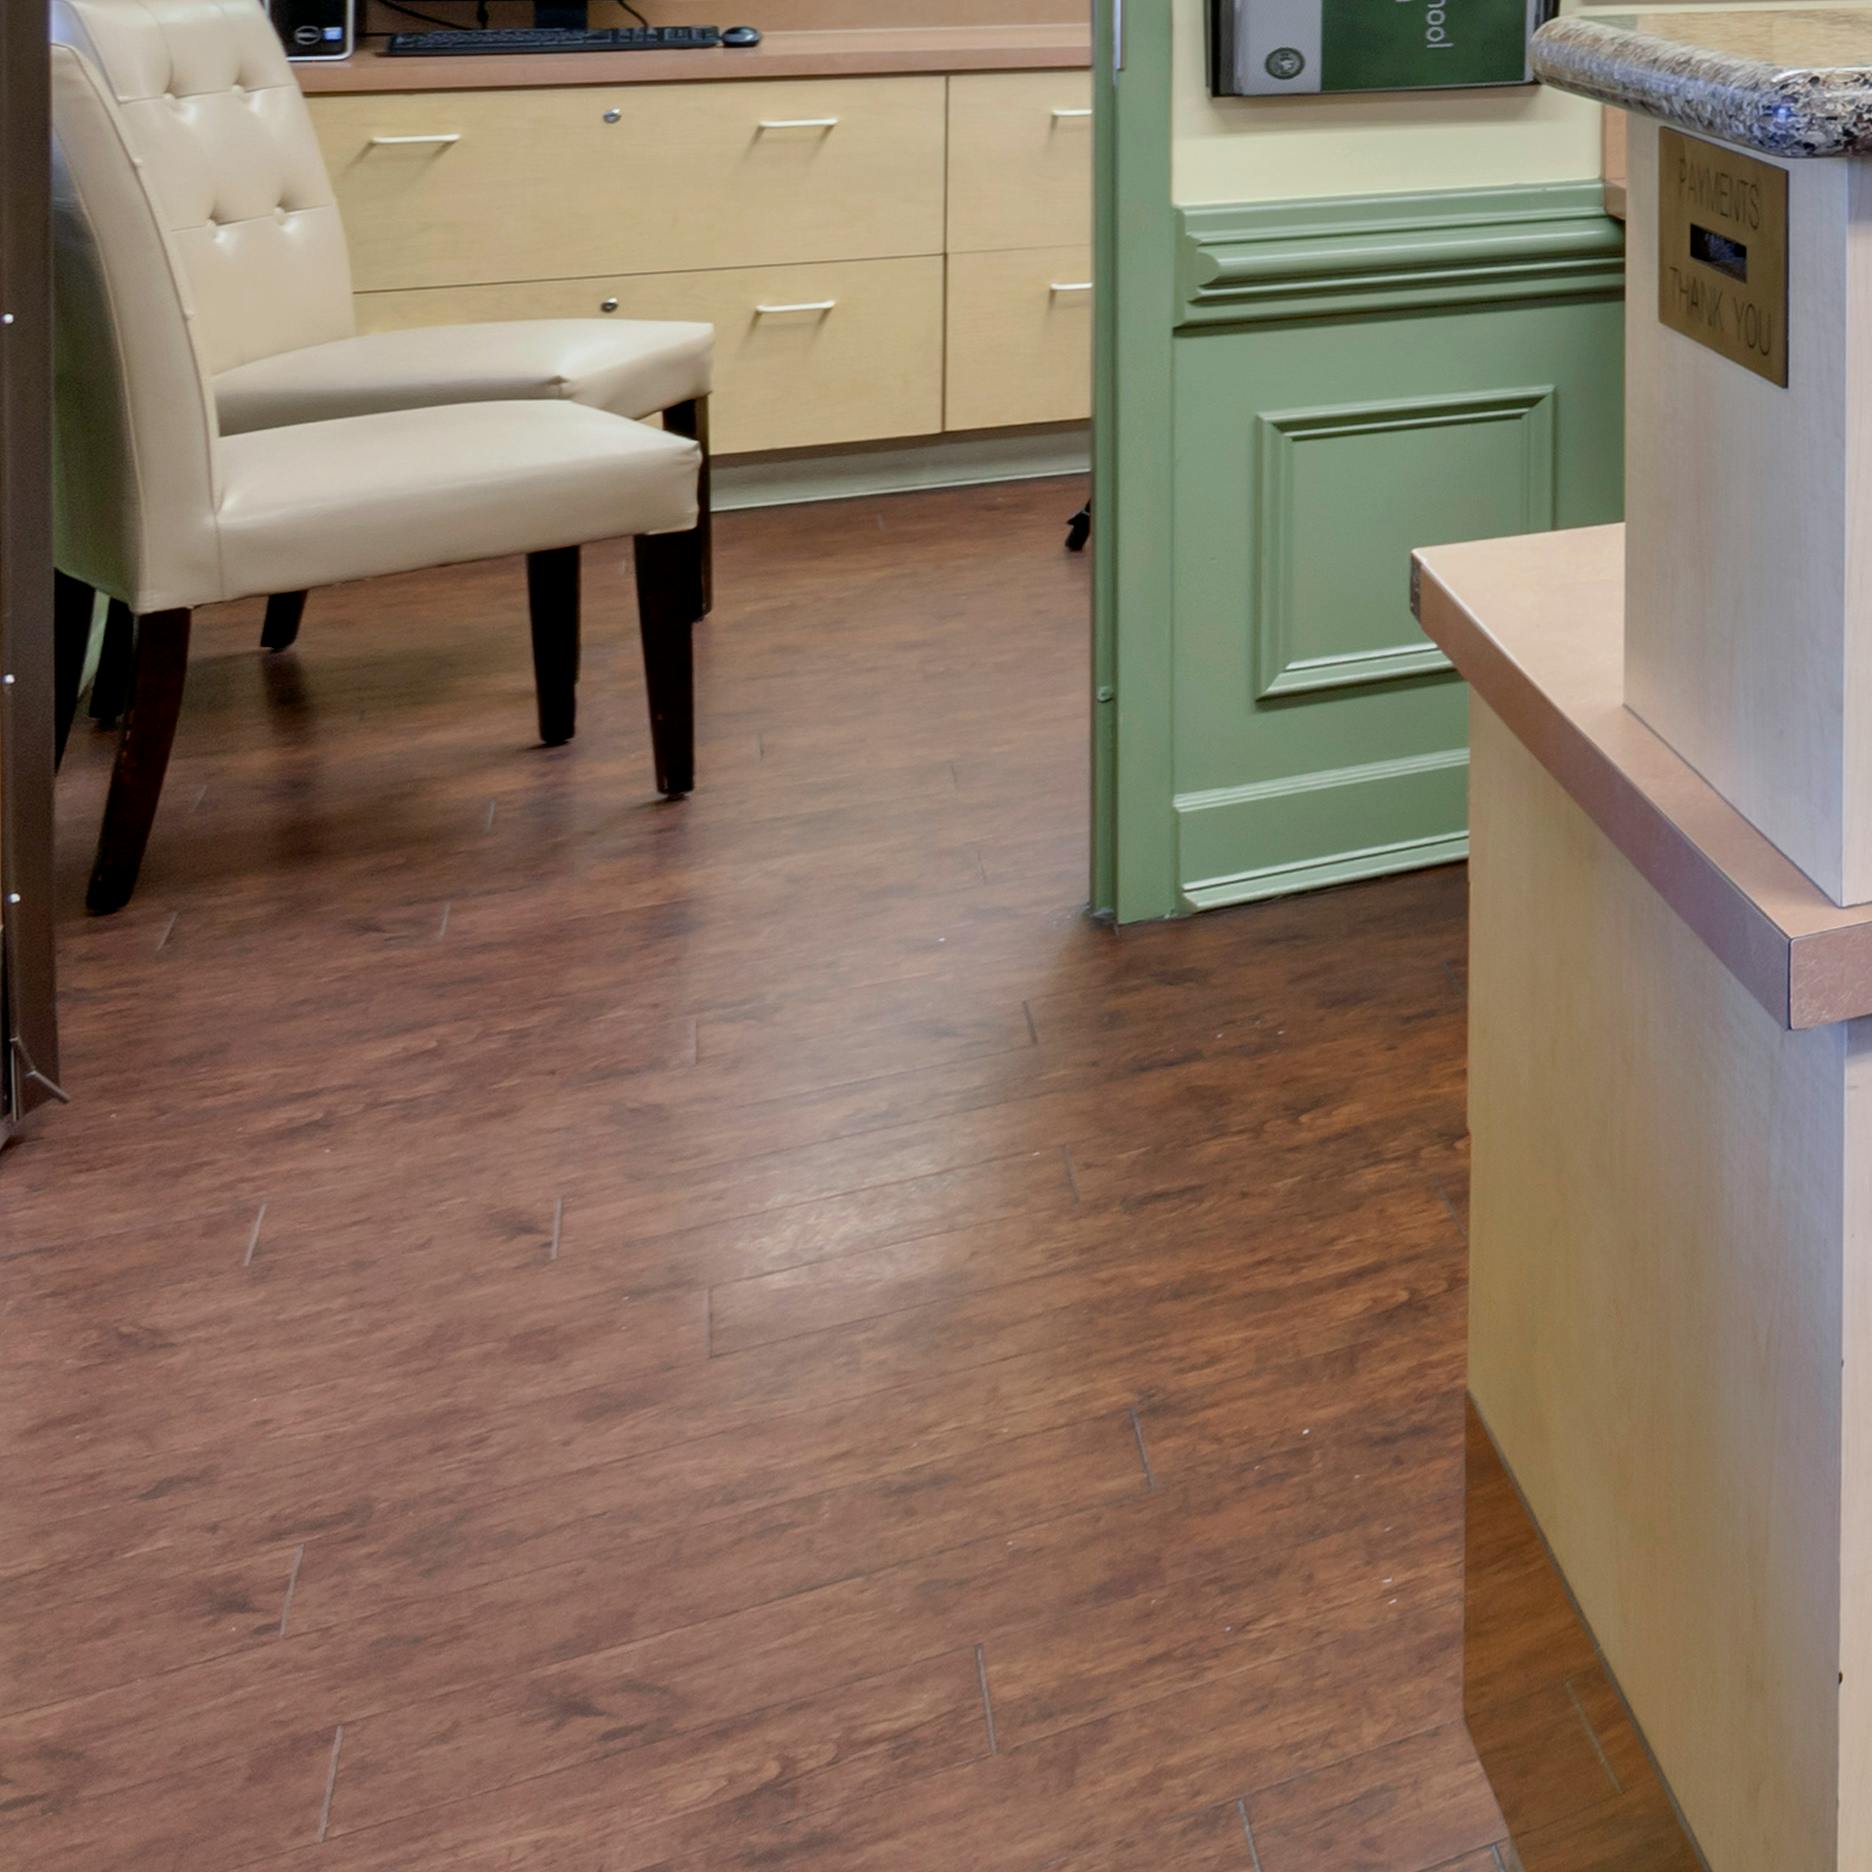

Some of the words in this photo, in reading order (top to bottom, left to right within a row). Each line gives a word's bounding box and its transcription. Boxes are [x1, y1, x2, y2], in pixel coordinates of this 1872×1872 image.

[1677, 158, 1762, 232] PAYMENTS
[1668, 266, 1726, 334] THANK
[1732, 295, 1774, 357] YOU
